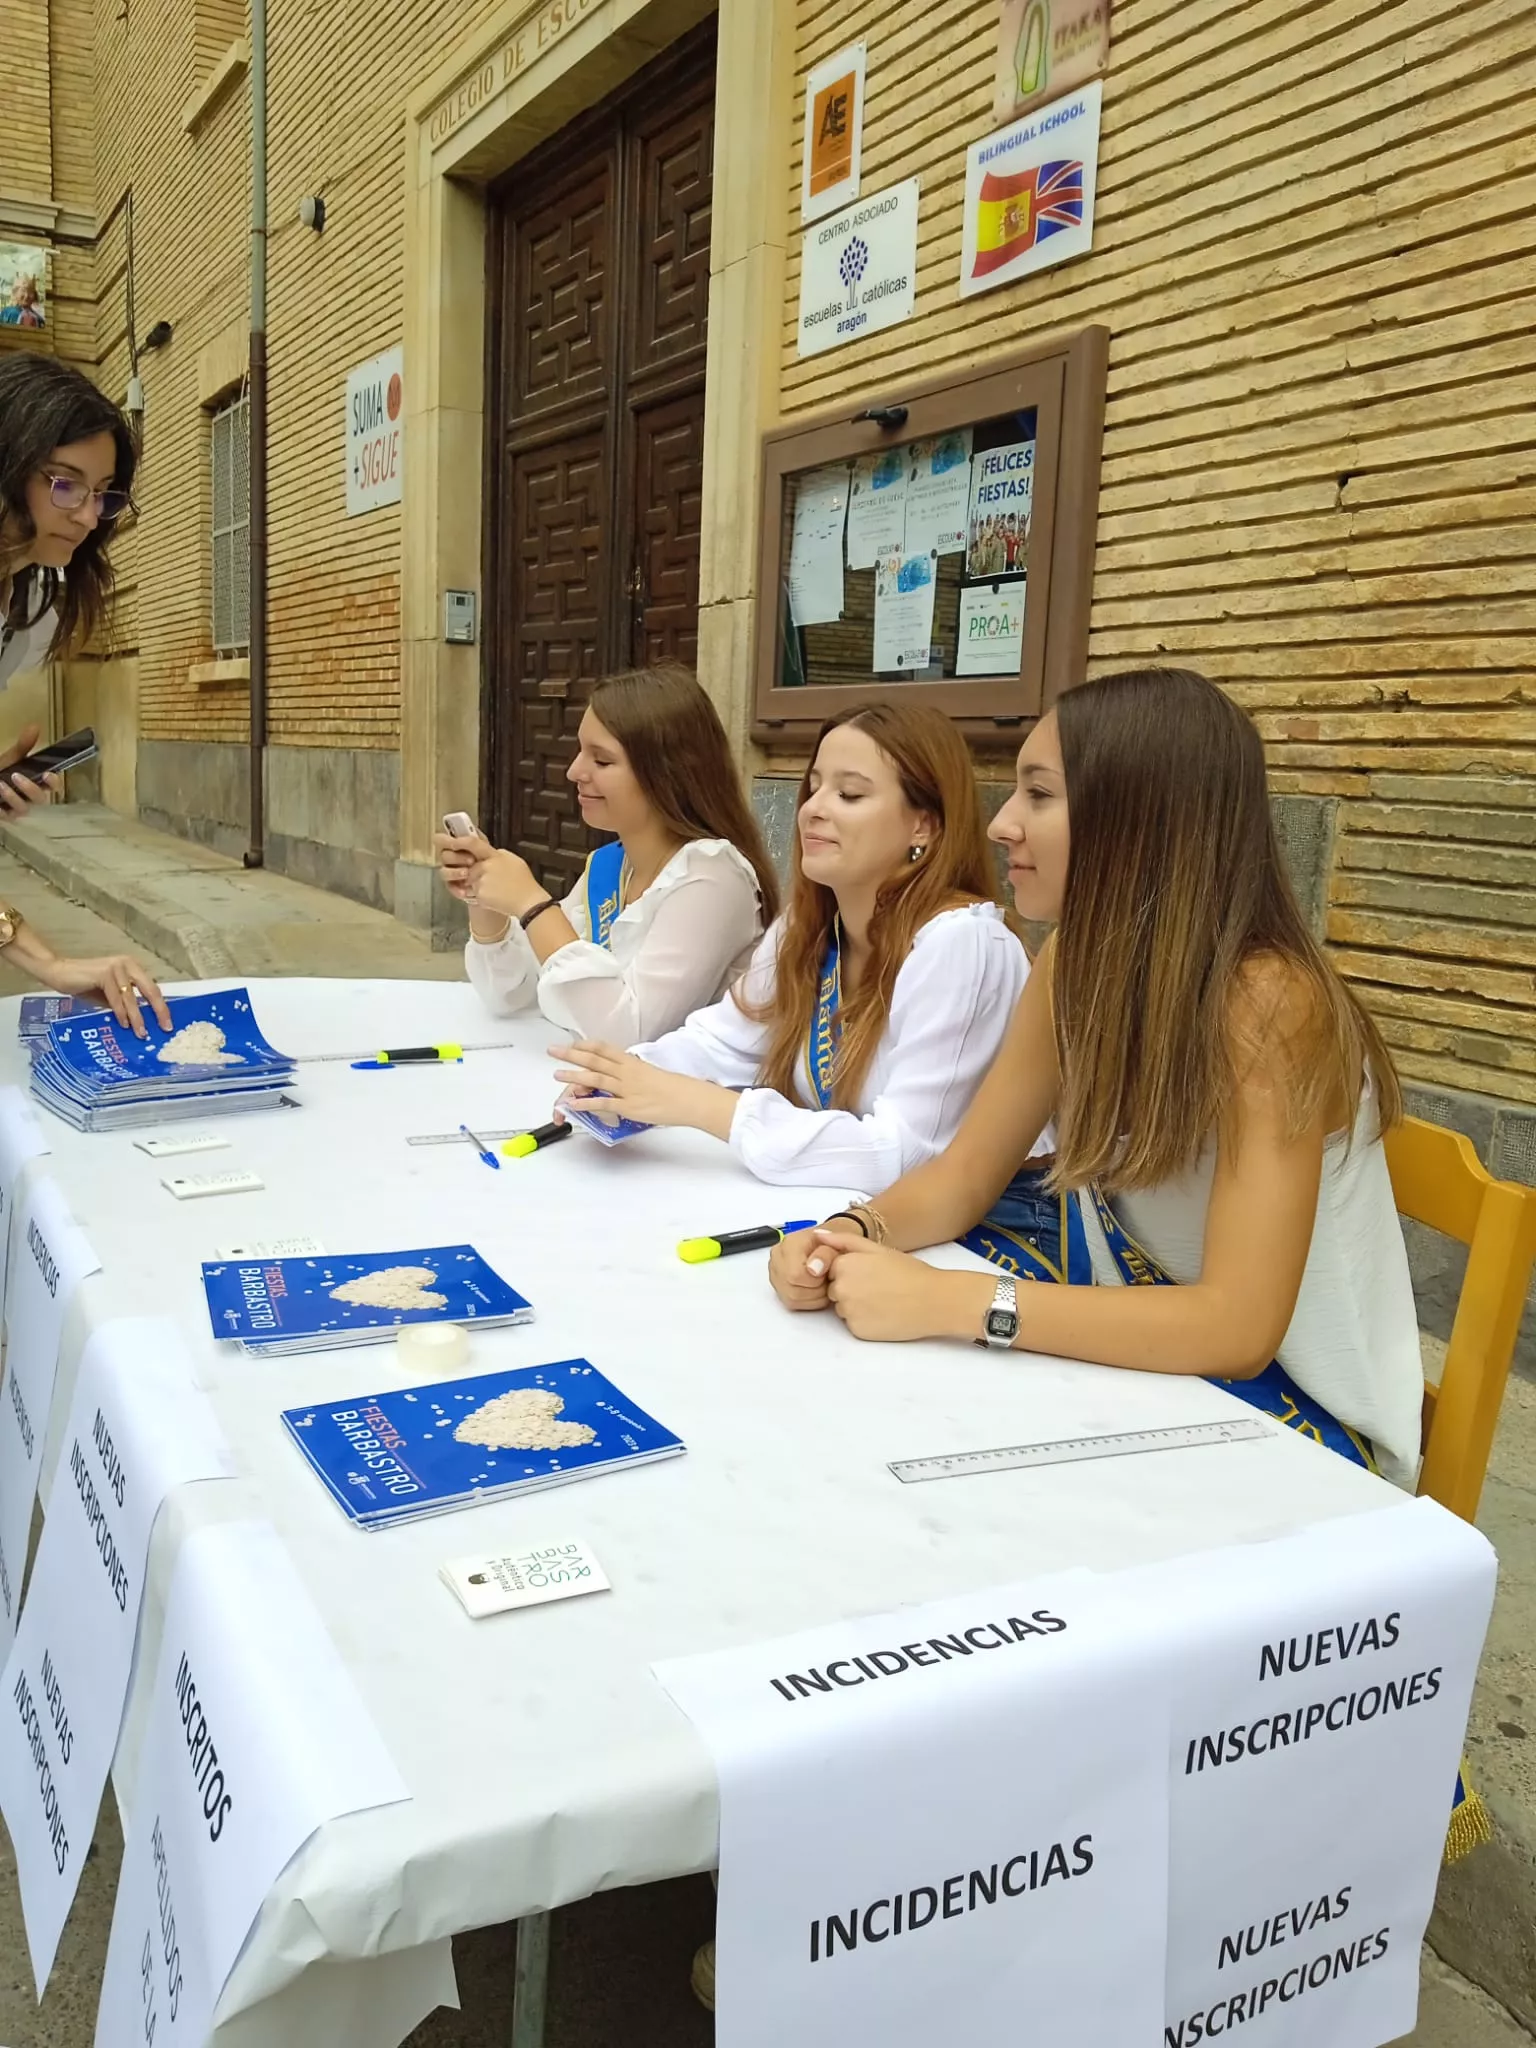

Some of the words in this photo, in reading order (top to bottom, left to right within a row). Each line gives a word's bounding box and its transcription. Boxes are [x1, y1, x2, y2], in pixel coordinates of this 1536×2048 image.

[429, 64, 494, 143] COLEGIO
[502, 33, 526, 81] DE
[978, 126, 1037, 165] BILINGUAL
[1038, 101, 1086, 135] SCHOOL
[818, 218, 850, 246] CENTRO
[852, 196, 898, 229] ASOCIADO
[803, 301, 843, 328] escuelas
[861, 275, 908, 305] católicas
[836, 310, 868, 333] aragón
[352, 379, 384, 437] SUMA
[977, 476, 1031, 505] FIESTAS!
[980, 448, 1033, 482] ¡FELICES
[968, 613, 1020, 638] PROA+
[97, 1025, 129, 1064] FIESTAS
[238, 1267, 277, 1330] BARBASTRO
[262, 1266, 288, 1299] FIESTAS
[92, 1407, 126, 1509] NUEVAS
[330, 1409, 419, 1496] BARBASTRO
[358, 1405, 407, 1449] FIESTAS
[70, 1437, 129, 1613] INSCRIPCIONES
[771, 1611, 1067, 1701] INCIDENCIAS
[1260, 1612, 1401, 1681] NUEVAS
[40, 1648, 73, 1765] NUEVAS
[1186, 1666, 1443, 1775] INSCRIPCIONES
[14, 1669, 69, 1875] INSCRIPCIONES
[175, 1650, 232, 1843] INSCRITOS
[151, 1815, 183, 2023] APELLIDOS
[811, 1834, 1094, 1963] INCIDENCIAS
[1218, 1886, 1352, 1970] NUEVAS
[1165, 1927, 1390, 2048] NSCRIPCIONES
